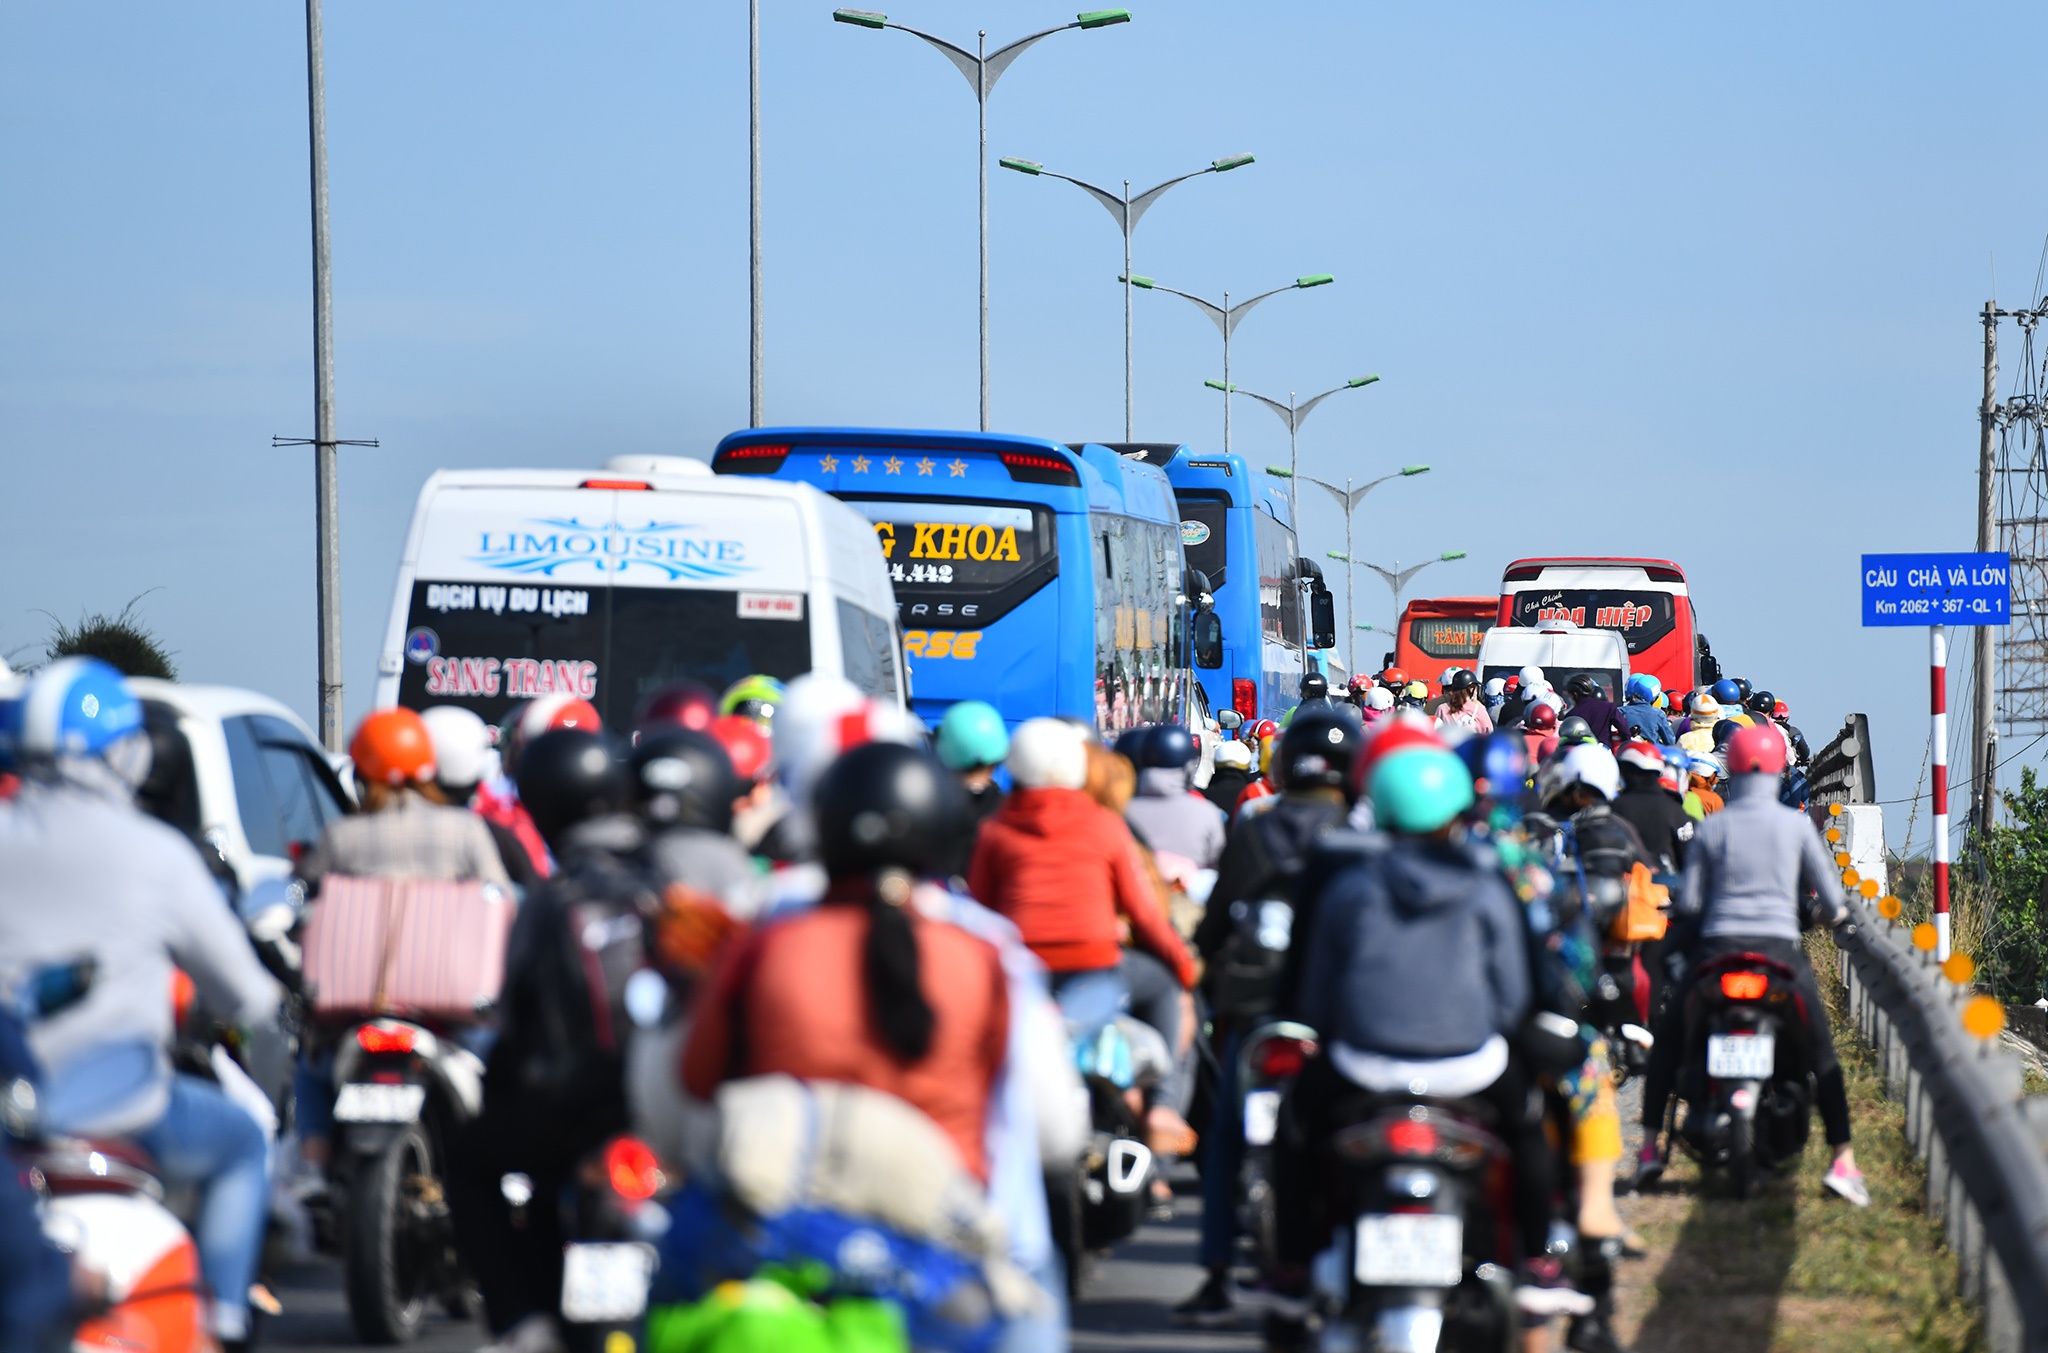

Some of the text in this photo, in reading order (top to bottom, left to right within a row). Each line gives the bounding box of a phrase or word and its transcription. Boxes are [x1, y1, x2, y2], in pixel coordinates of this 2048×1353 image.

[479, 532, 746, 562] LIMOUSINE
[908, 523, 1021, 562] KHOA
[884, 562, 954, 584] 4.442
[1907, 564, 1942, 587] CHÀ
[1947, 564, 1968, 586] VÀ
[1972, 563, 2006, 586] LỚN
[427, 585, 589, 618] DỊCH VỤ DU LỊCH
[1537, 600, 1653, 631] HÒA HIỆP
[1875, 600, 1896, 613] Km
[1900, 600, 1929, 613] 2062
[1942, 600, 1963, 613] 367
[1972, 599, 1990, 614] QL
[1995, 598, 2002, 612] 1
[1434, 628, 1466, 645] TÂM
[426, 656, 597, 699] SANG TRANG
